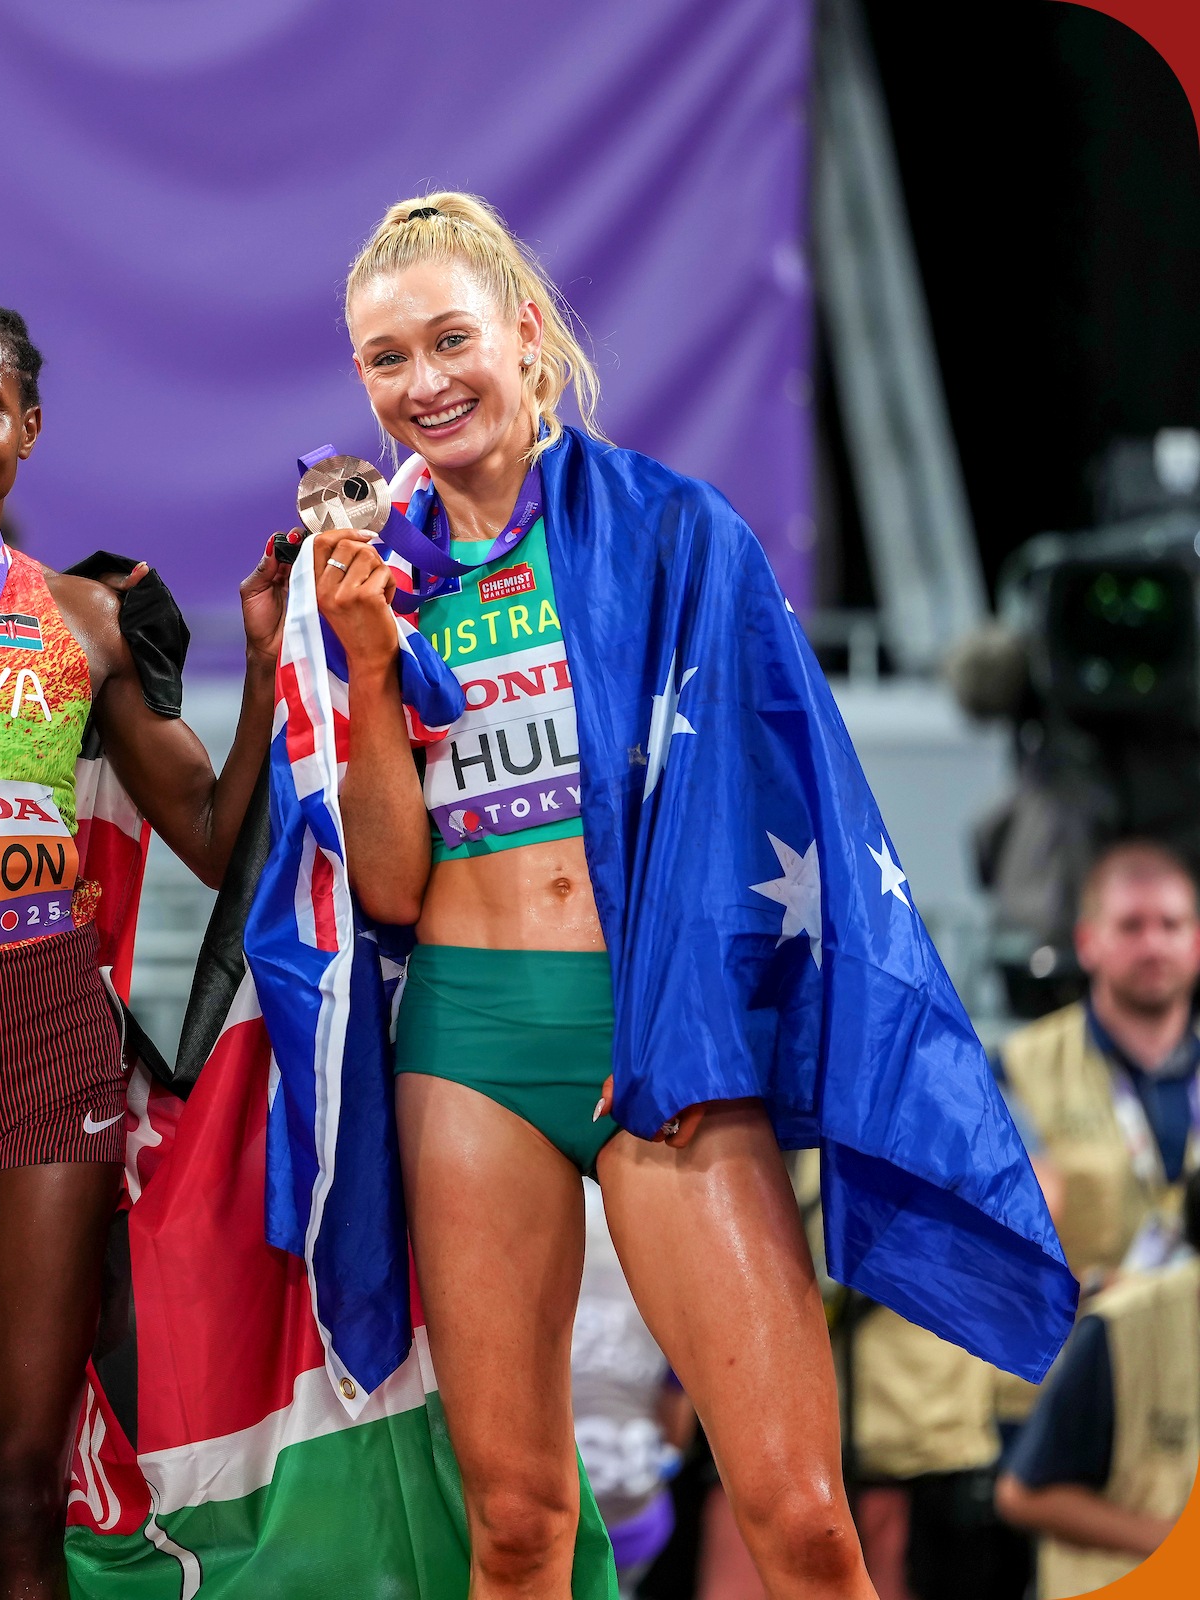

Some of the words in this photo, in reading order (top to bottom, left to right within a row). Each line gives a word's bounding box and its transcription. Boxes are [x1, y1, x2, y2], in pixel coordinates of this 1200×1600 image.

[481, 572, 531, 593] CHEMIST
[483, 583, 531, 599] WAREHOUSE
[431, 600, 561, 662] USTRA
[451, 718, 580, 790] HUL
[484, 785, 581, 824] TOKY
